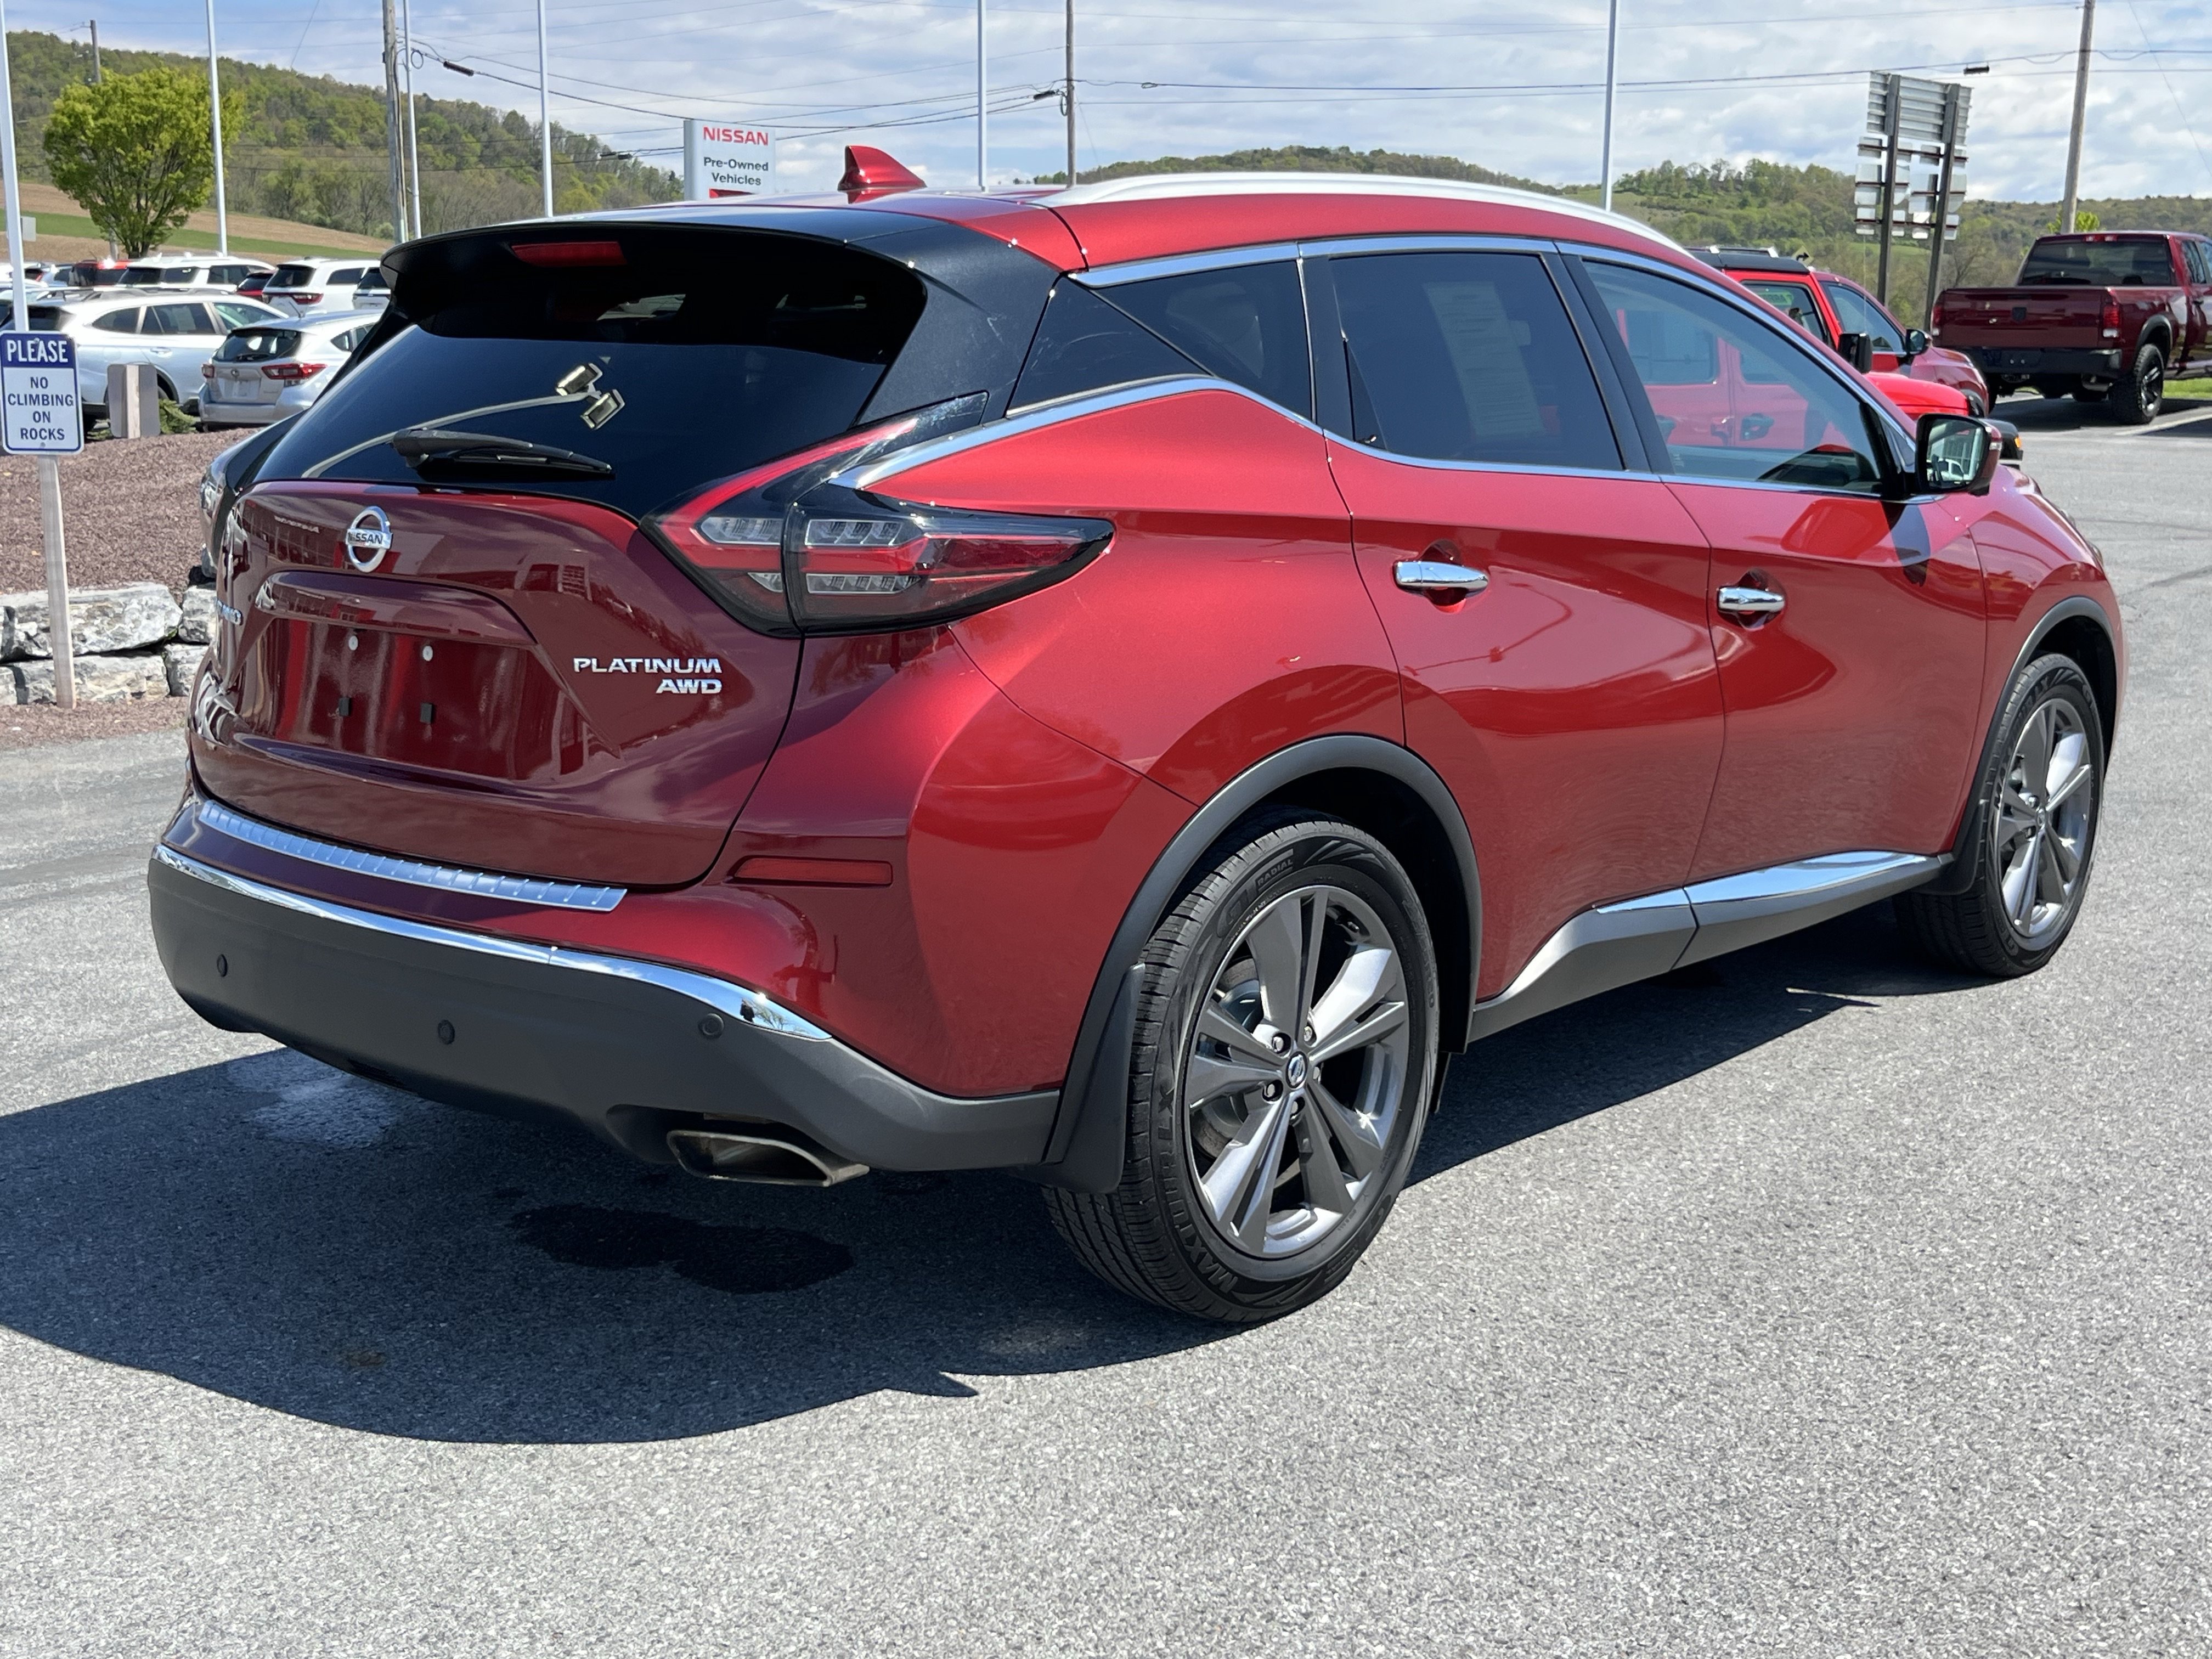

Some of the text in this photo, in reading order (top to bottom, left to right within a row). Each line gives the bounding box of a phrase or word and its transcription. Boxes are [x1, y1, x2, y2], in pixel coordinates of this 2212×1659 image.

[703, 127, 769, 146] NISSAN
[704, 157, 769, 171] Pre-Owned
[712, 172, 761, 185] Vehicles
[7, 339, 68, 363] PLEASE
[30, 377, 48, 389] NO
[8, 393, 74, 406] CLIMBING
[33, 411, 50, 423] ON
[20, 428, 65, 440] ROCKS
[573, 658, 722, 673] PLATINUM
[656, 679, 722, 694] AWD
[1257, 857, 1293, 887] RADIAL
[1157, 1082, 1238, 1294] MAXTOUR LX
